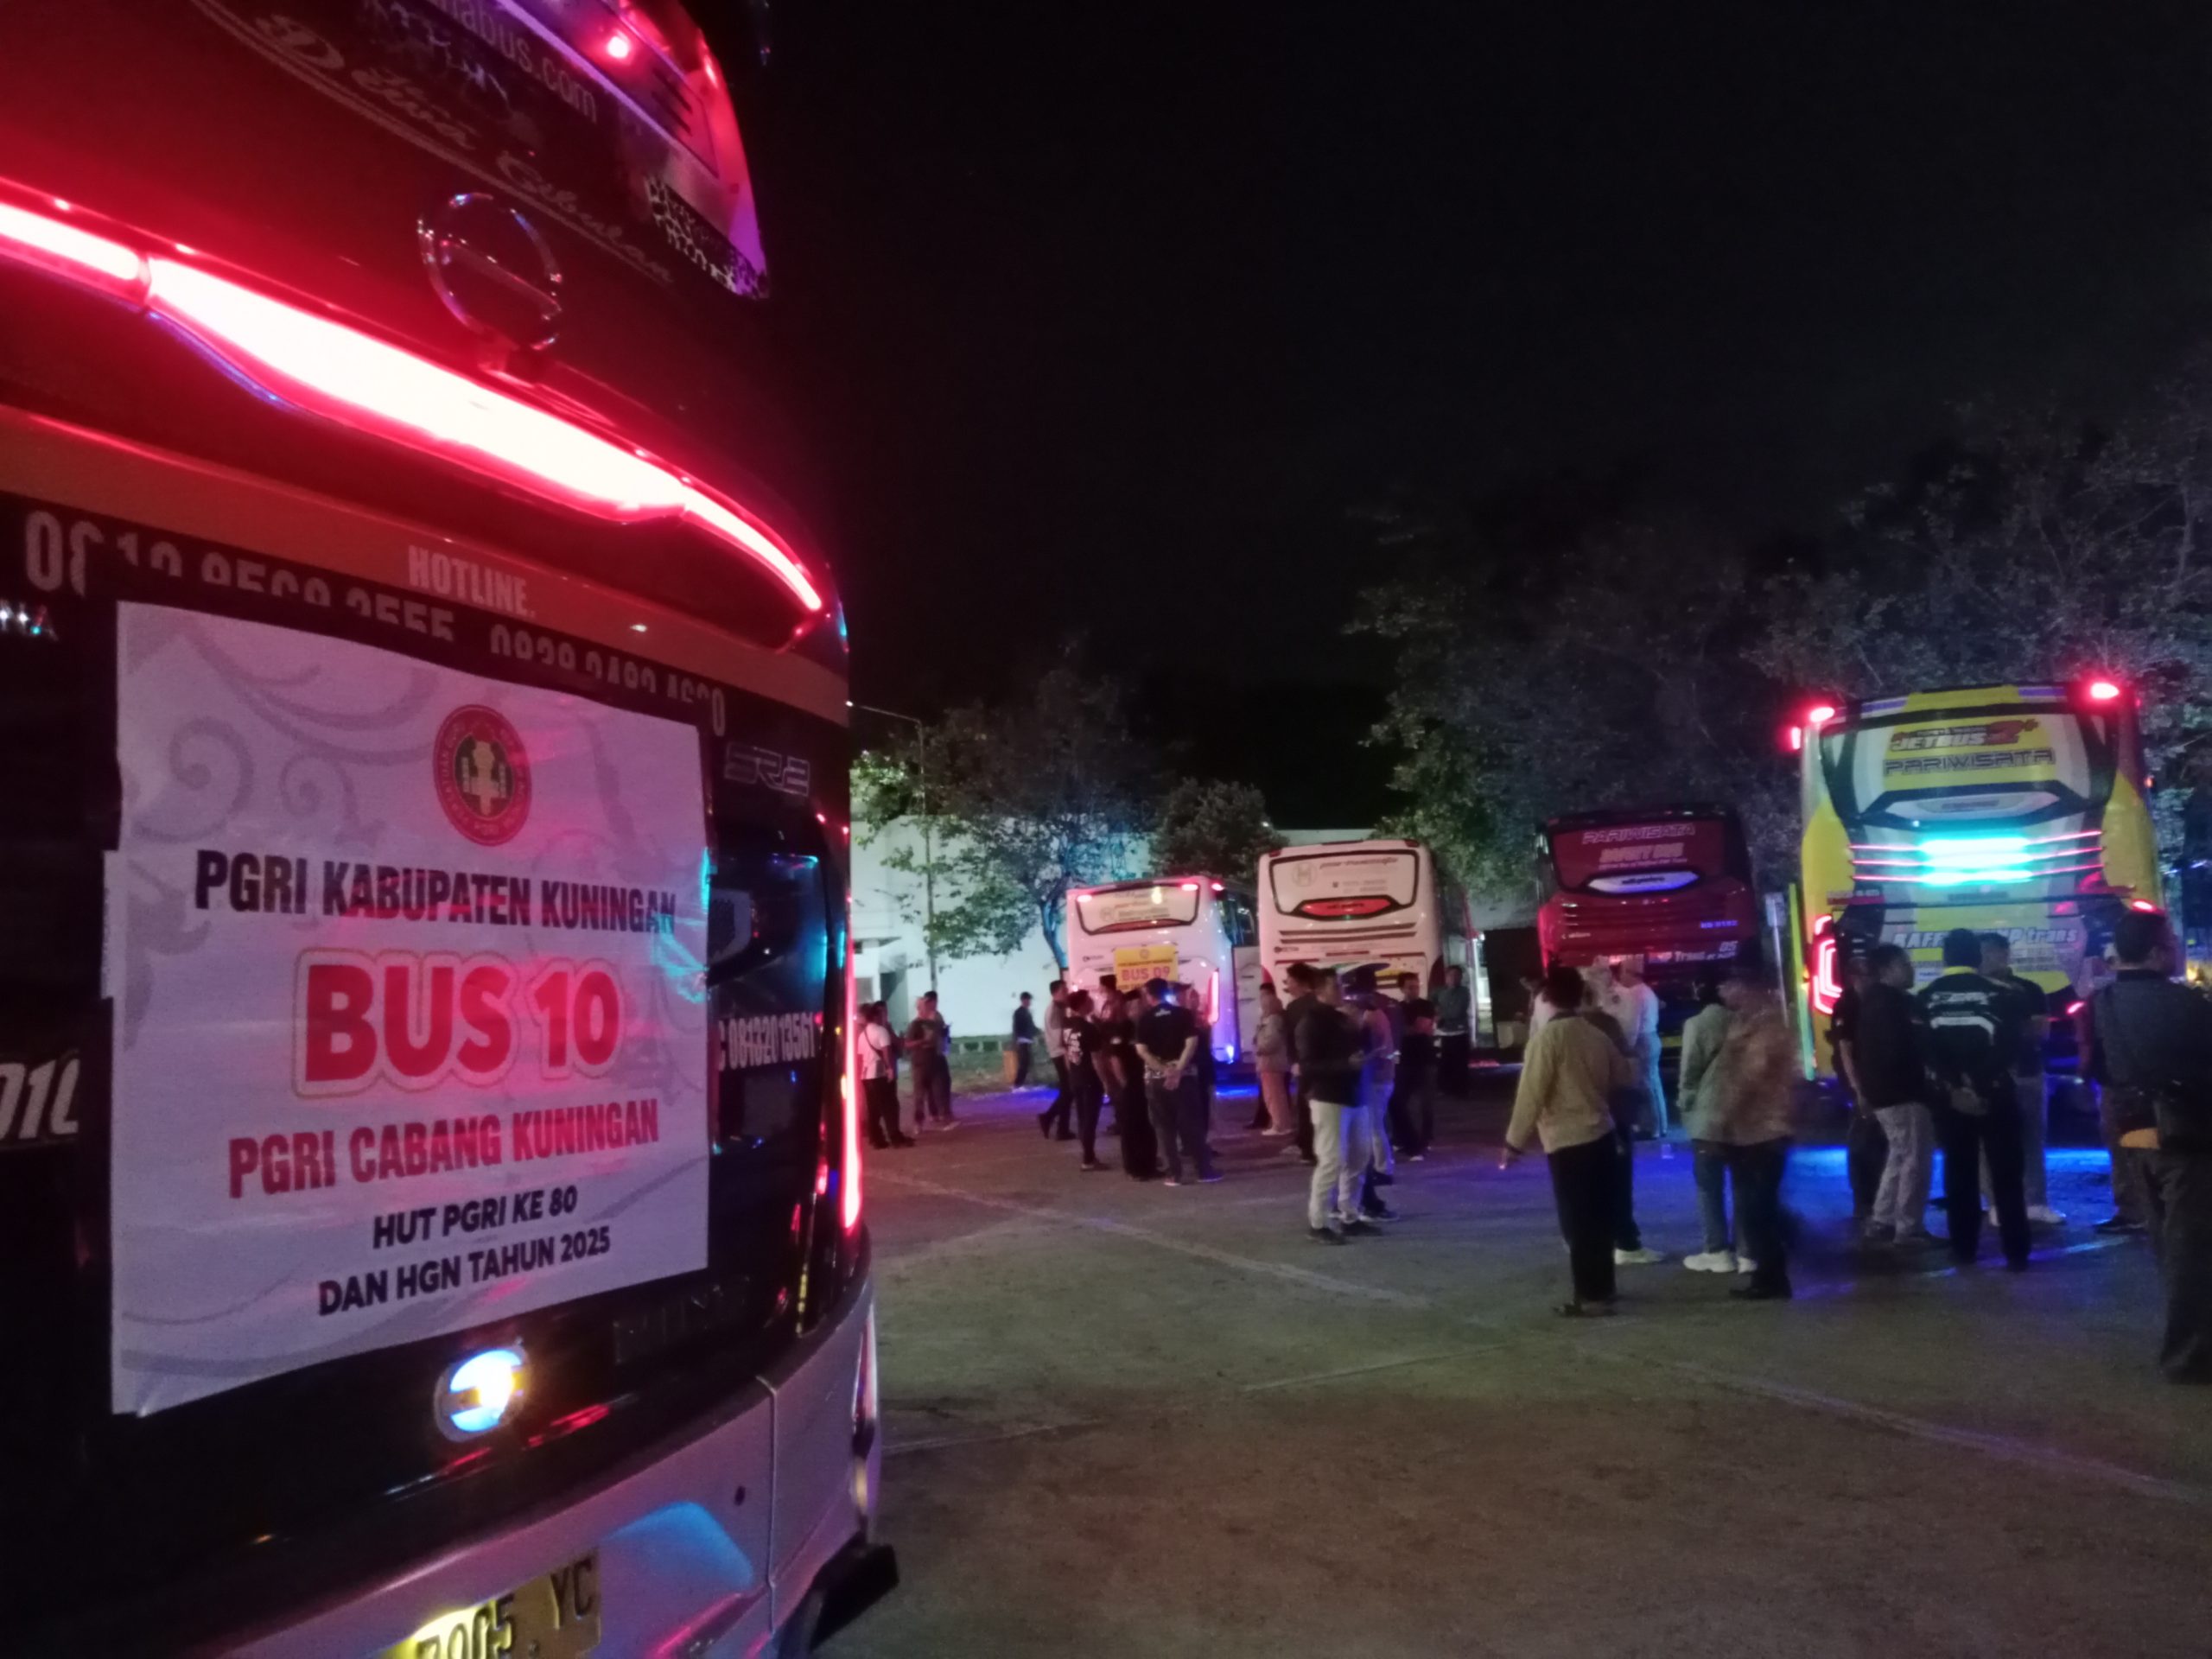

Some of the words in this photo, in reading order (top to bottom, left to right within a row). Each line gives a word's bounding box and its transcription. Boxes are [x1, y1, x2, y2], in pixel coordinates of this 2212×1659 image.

[1883, 748, 2056, 777] PARIWISATA
[1581, 823, 1696, 845] PARIWISATA
[195, 849, 308, 914] PGRI
[323, 861, 531, 926] KABUPATEN
[542, 880, 676, 934] KUNINGAN
[1122, 968, 1149, 982] BUS
[306, 963, 512, 1082] BUS
[534, 970, 620, 1068] 10
[229, 1130, 336, 1198] PGRI
[350, 1114, 503, 1183] CABANG
[513, 1098, 659, 1161] KUNINGAN
[373, 1208, 436, 1249] HUT
[442, 1196, 507, 1237] PGRI
[512, 1190, 545, 1224] KE
[549, 1185, 578, 1217] 80
[318, 1270, 389, 1316] DAN
[396, 1255, 461, 1300] HGN
[468, 1236, 555, 1283] TAHUN
[560, 1226, 611, 1262] 2025
[550, 1558, 593, 1630] YC
